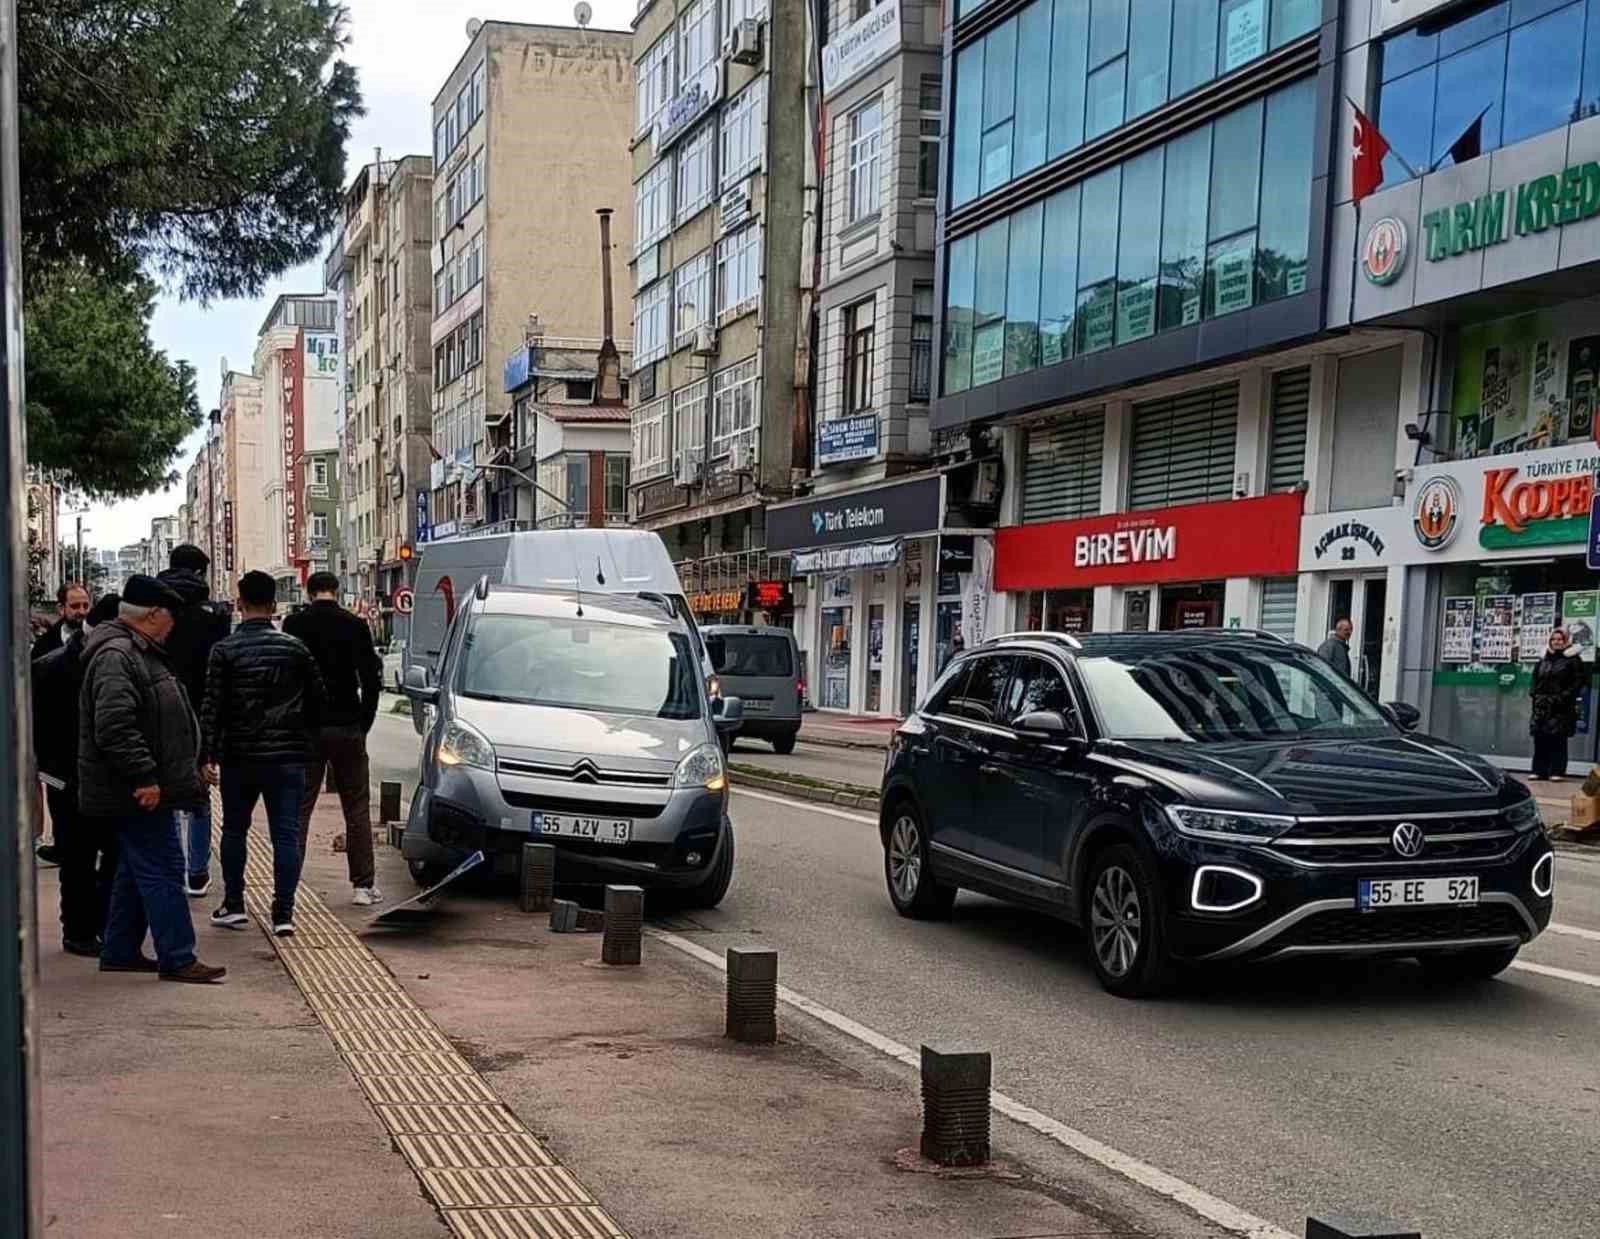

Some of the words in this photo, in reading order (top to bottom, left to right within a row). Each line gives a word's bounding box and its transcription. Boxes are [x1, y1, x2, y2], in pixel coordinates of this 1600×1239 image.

[1423, 190, 1508, 261] TARIM
[284, 376, 294, 403] MY
[285, 414, 294, 482] HOUSE
[1526, 459, 1573, 477] TÜRKİYE
[287, 491, 296, 558] HOTEL
[824, 511, 844, 531] Türk
[845, 506, 884, 529] Telekom
[544, 816, 560, 832] 55
[572, 819, 599, 835] AZV
[613, 822, 627, 839] 13
[1371, 883, 1392, 903] 55
[1404, 881, 1425, 902] EE
[1448, 879, 1476, 900] 521
